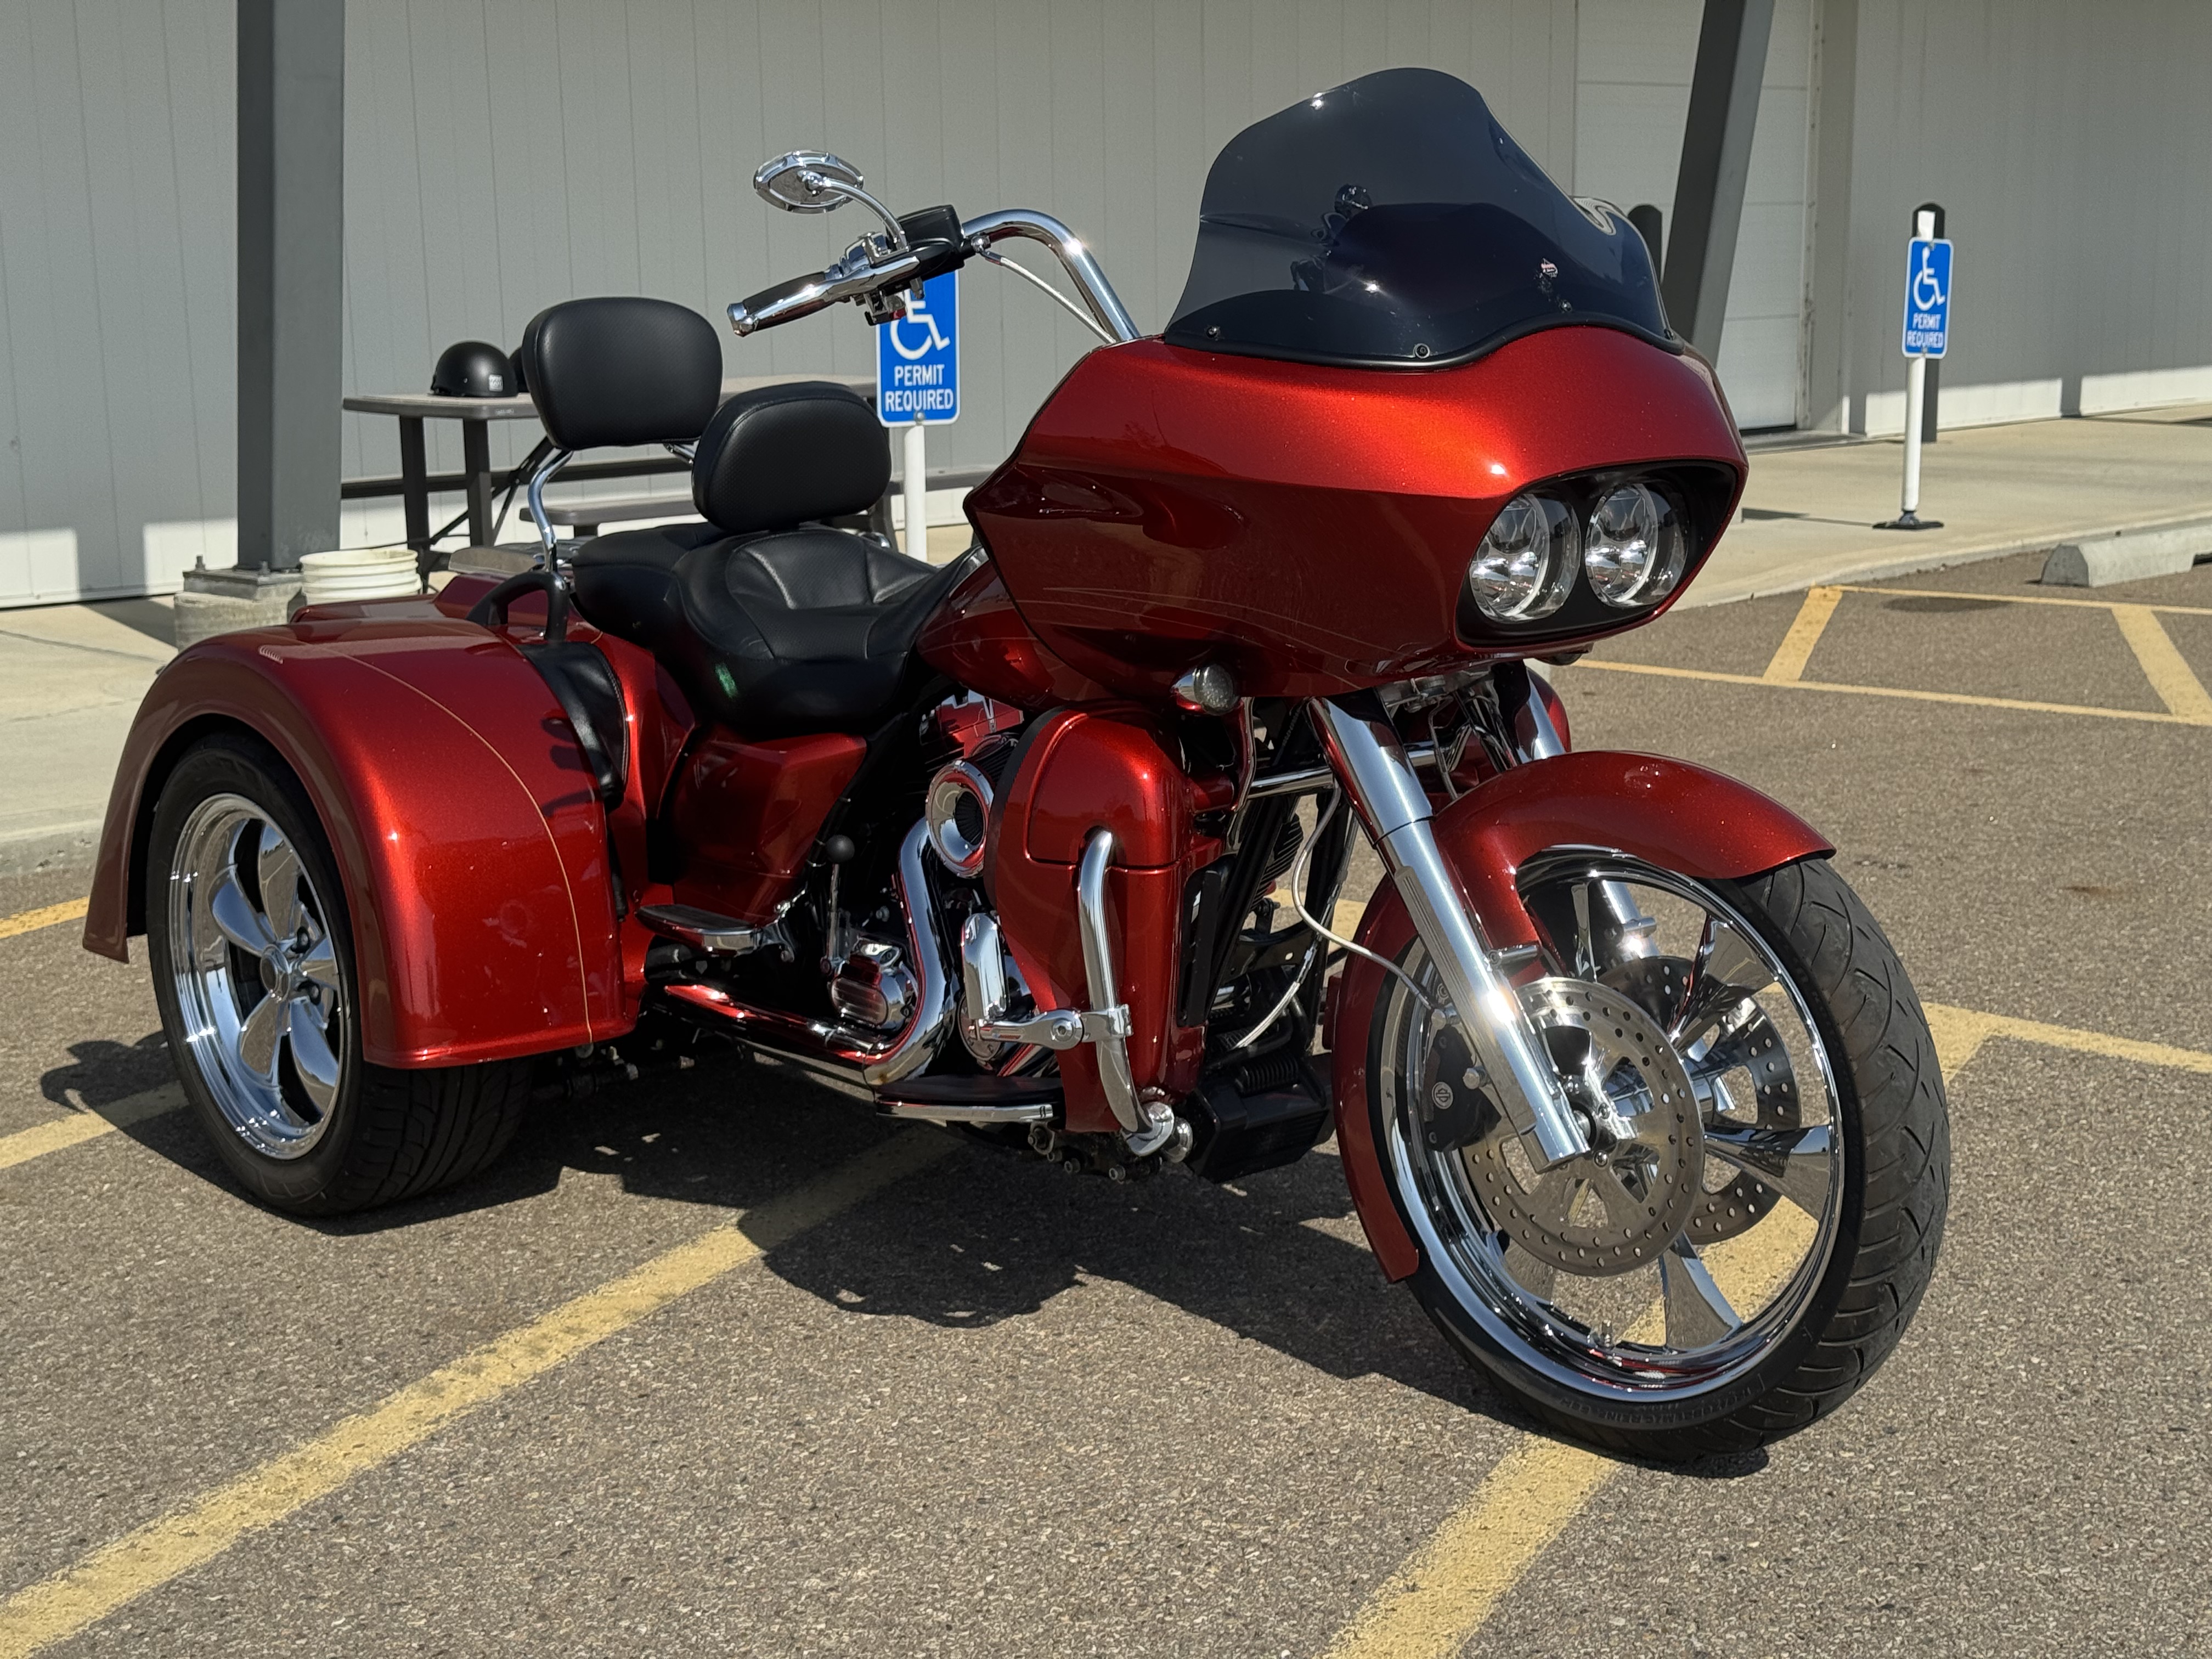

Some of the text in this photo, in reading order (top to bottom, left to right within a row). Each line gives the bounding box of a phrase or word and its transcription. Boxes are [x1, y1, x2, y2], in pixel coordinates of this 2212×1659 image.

[1912, 312, 1942, 330] PERMIT
[1906, 330, 1944, 348] REQUIRED
[894, 364, 945, 387] PERMIT
[885, 388, 953, 412] REQUIRED
